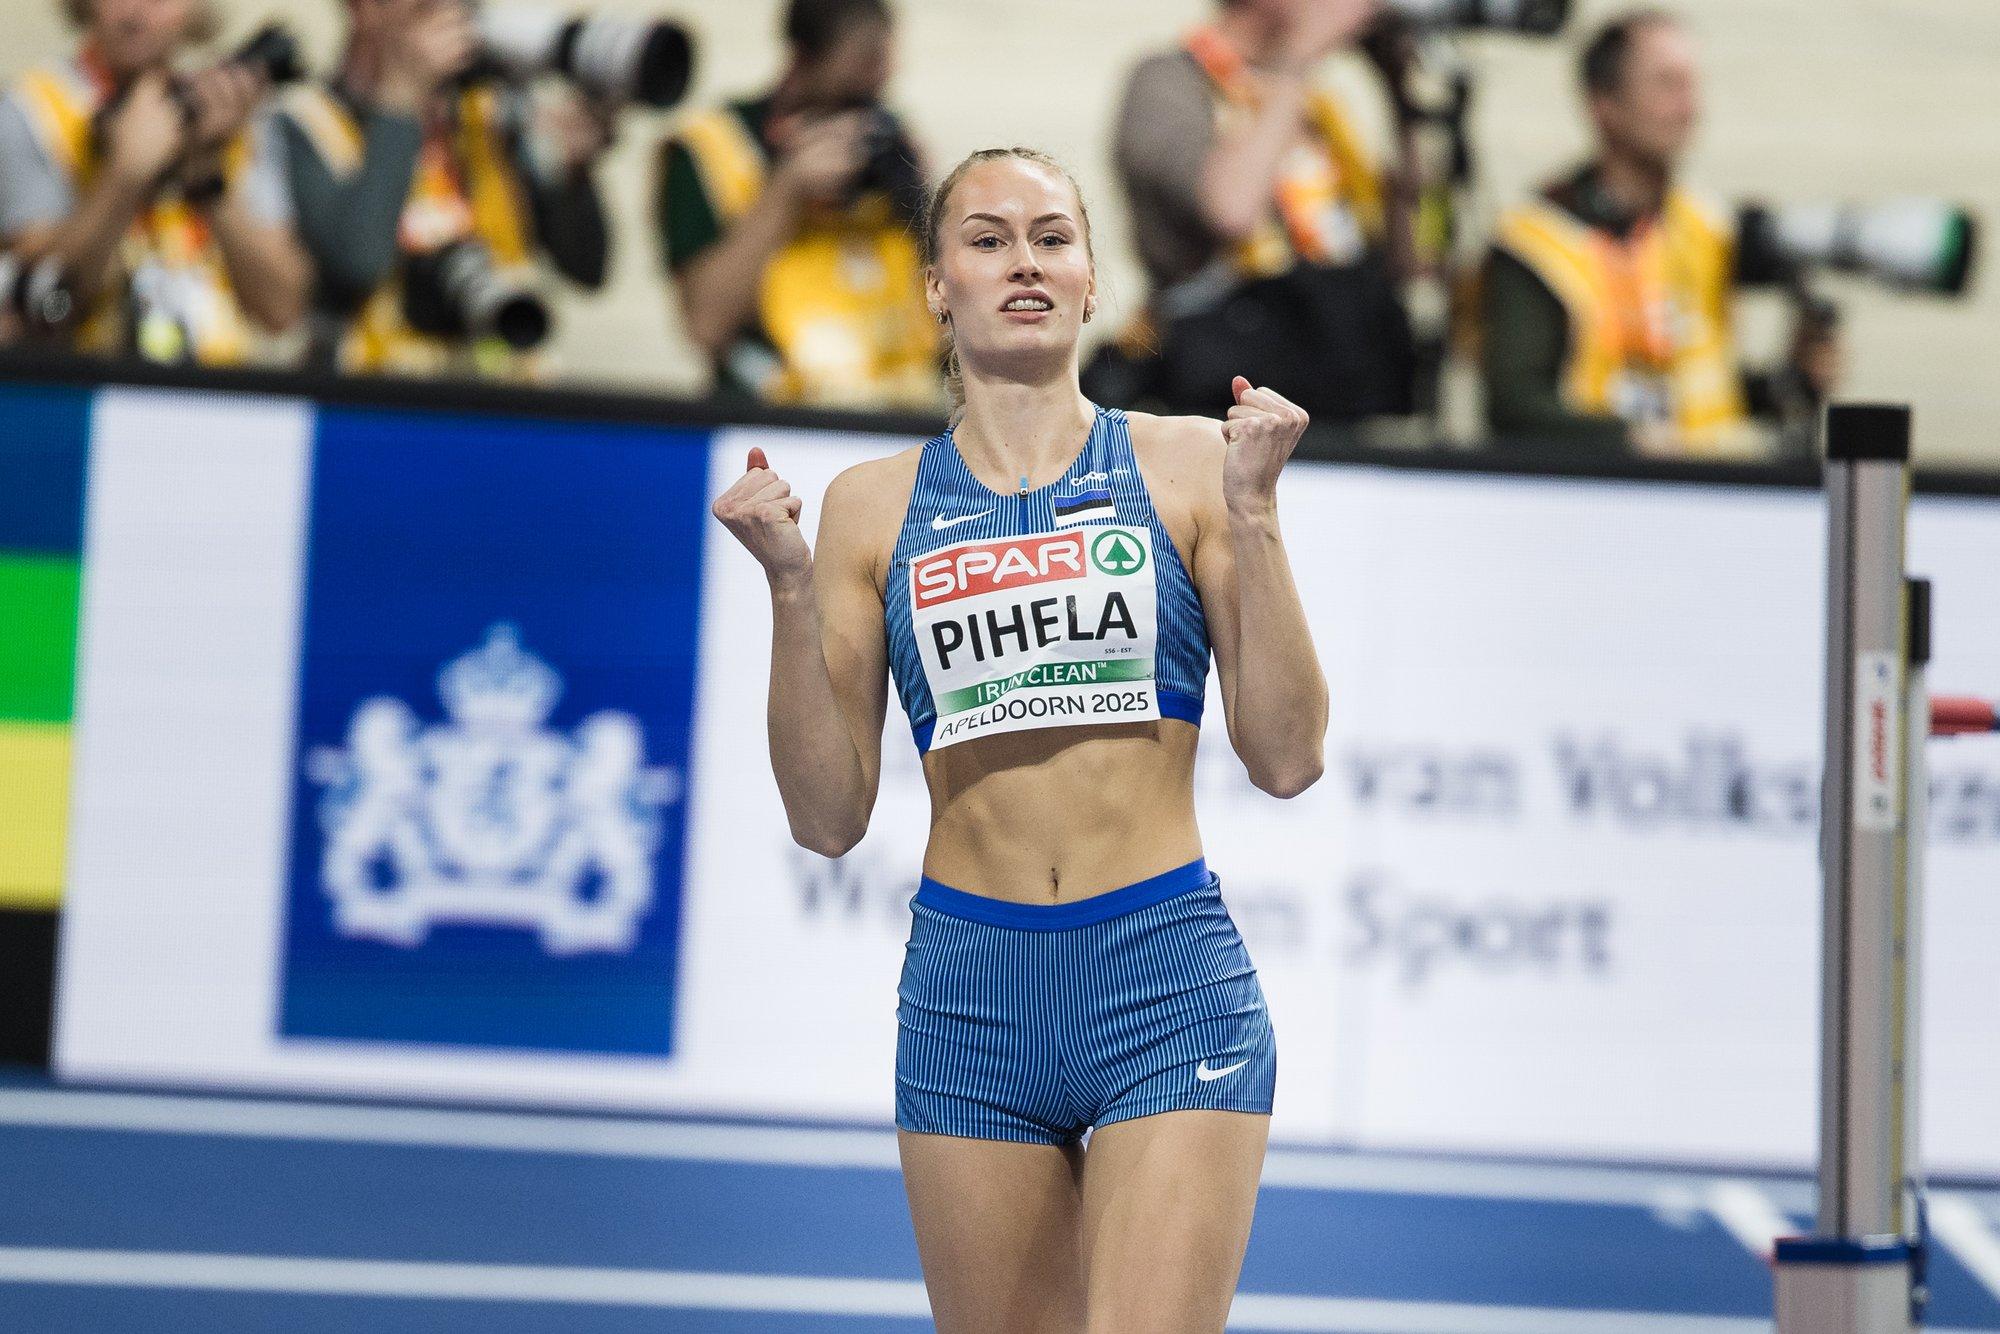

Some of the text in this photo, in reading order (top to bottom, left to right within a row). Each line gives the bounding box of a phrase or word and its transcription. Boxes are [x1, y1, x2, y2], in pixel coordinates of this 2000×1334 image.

[917, 539, 1082, 601] SPAR
[930, 591, 1139, 671] PIHELA
[976, 686, 983, 703] I
[985, 672, 1025, 702] RUN
[938, 691, 1149, 740] APELDOORN 2025
